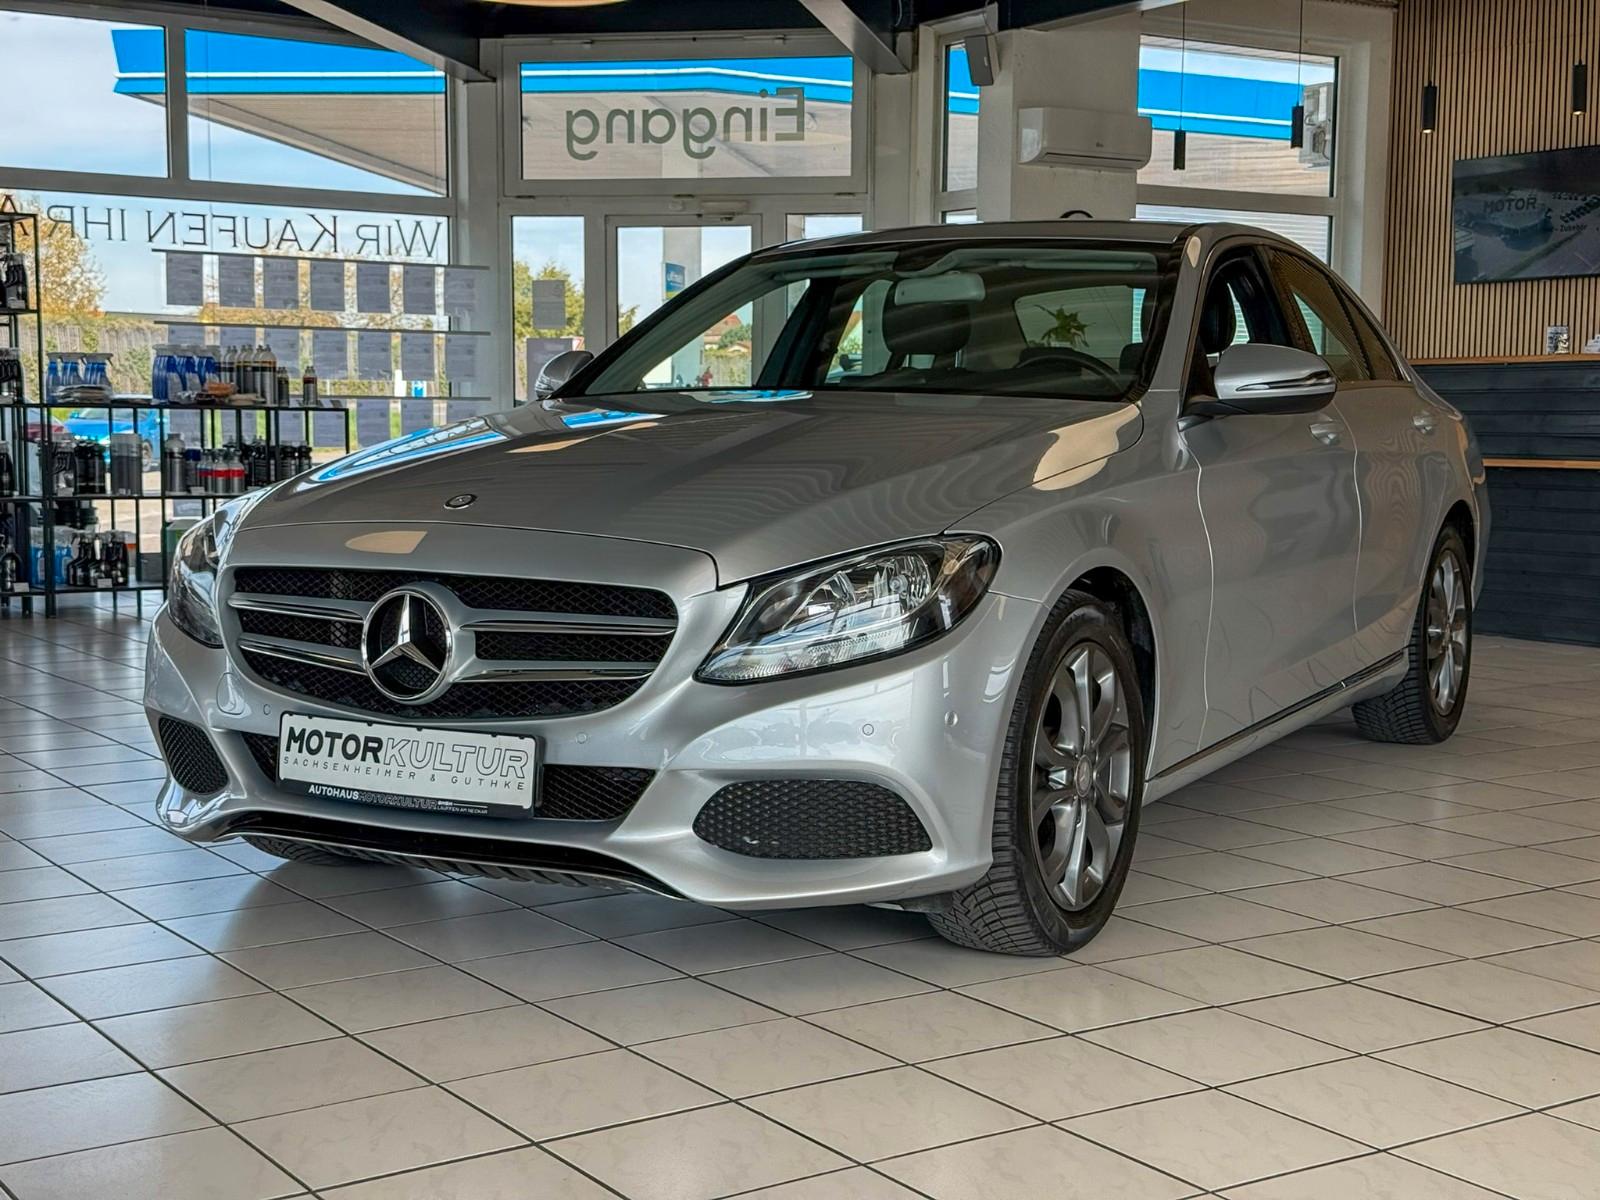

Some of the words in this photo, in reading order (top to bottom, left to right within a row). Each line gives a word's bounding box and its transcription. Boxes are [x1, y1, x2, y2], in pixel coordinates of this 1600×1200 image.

[283, 756, 416, 780] SACHSENHEIMER
[429, 773, 437, 782] &
[451, 775, 525, 791] GUTHKE
